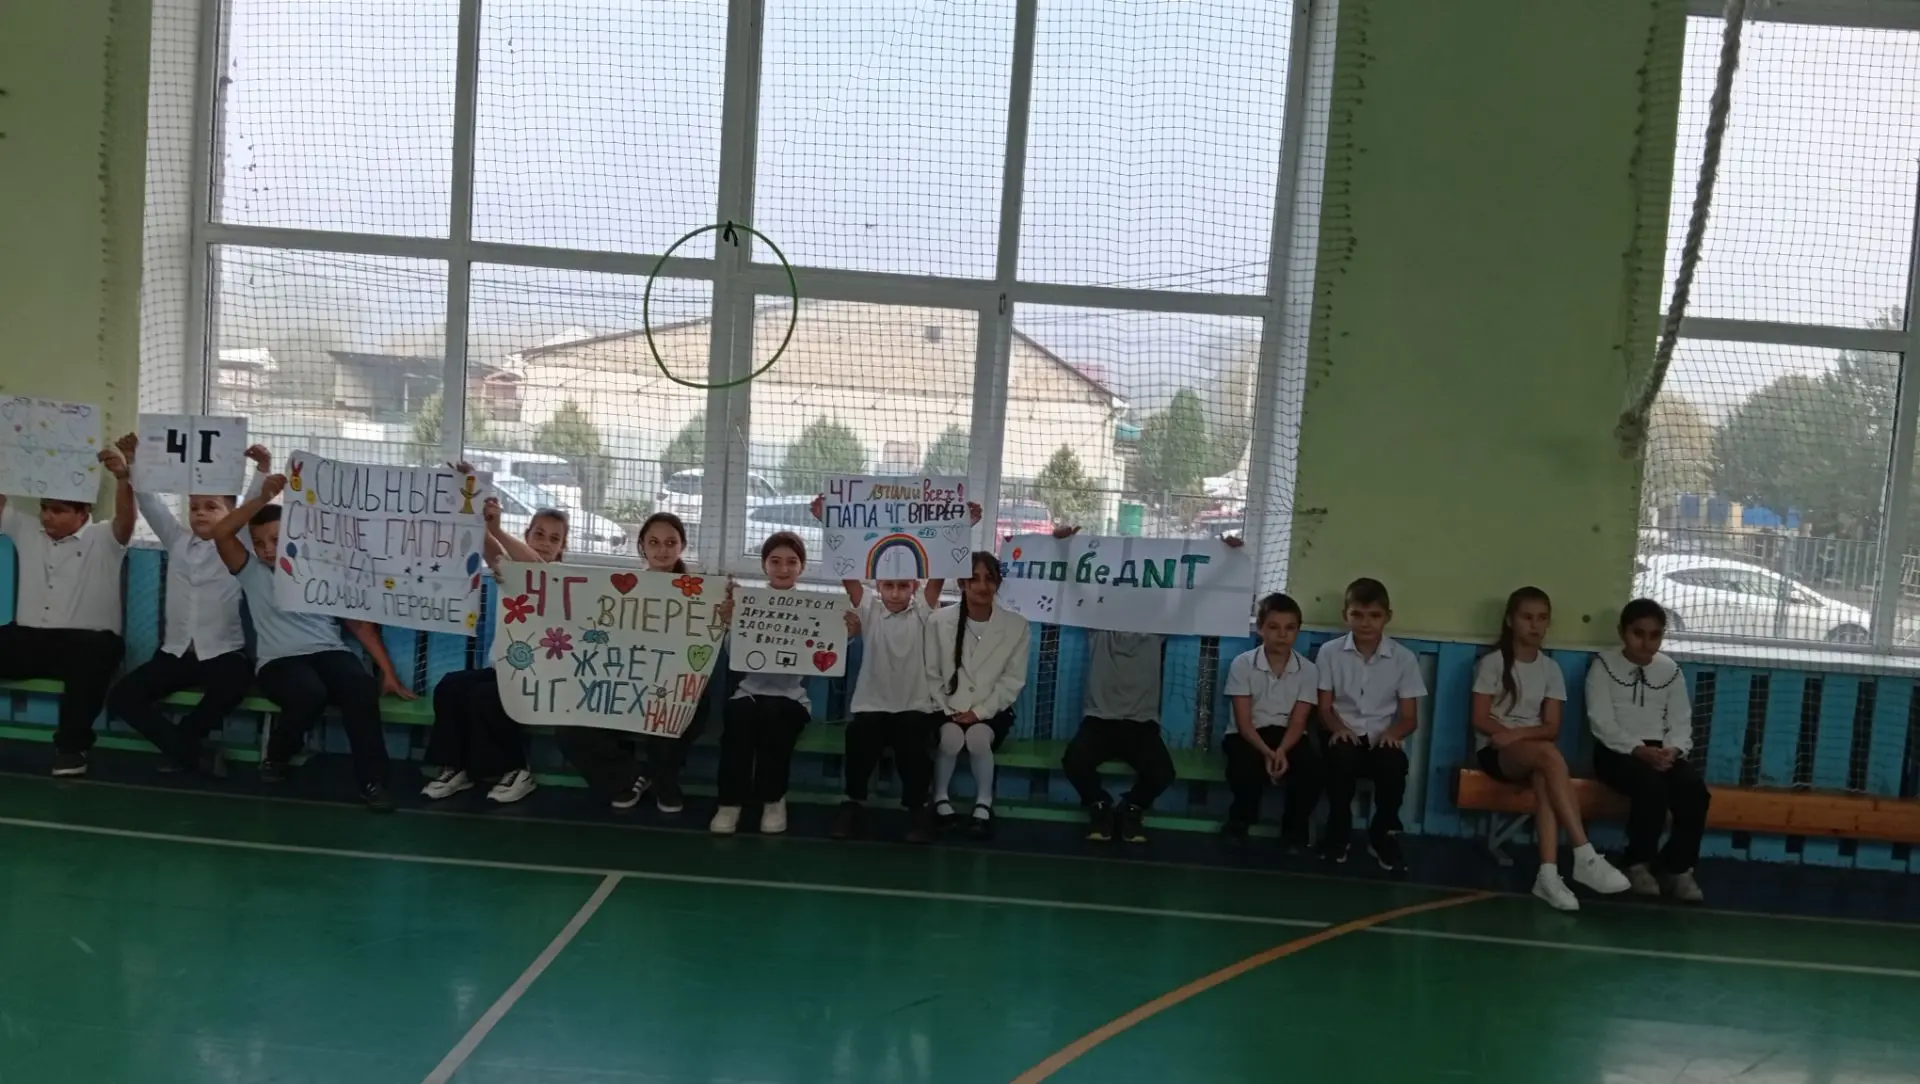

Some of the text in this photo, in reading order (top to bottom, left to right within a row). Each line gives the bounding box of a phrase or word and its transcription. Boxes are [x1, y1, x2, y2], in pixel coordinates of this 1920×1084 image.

[826, 503, 878, 528] ПАПА
[384, 518, 456, 558] ПАПЫ
[382, 592, 463, 623] ПЕРВЫЕ
[768, 596, 835, 610] СПОРТОМ
[571, 644, 675, 682] ЖДЁТ
